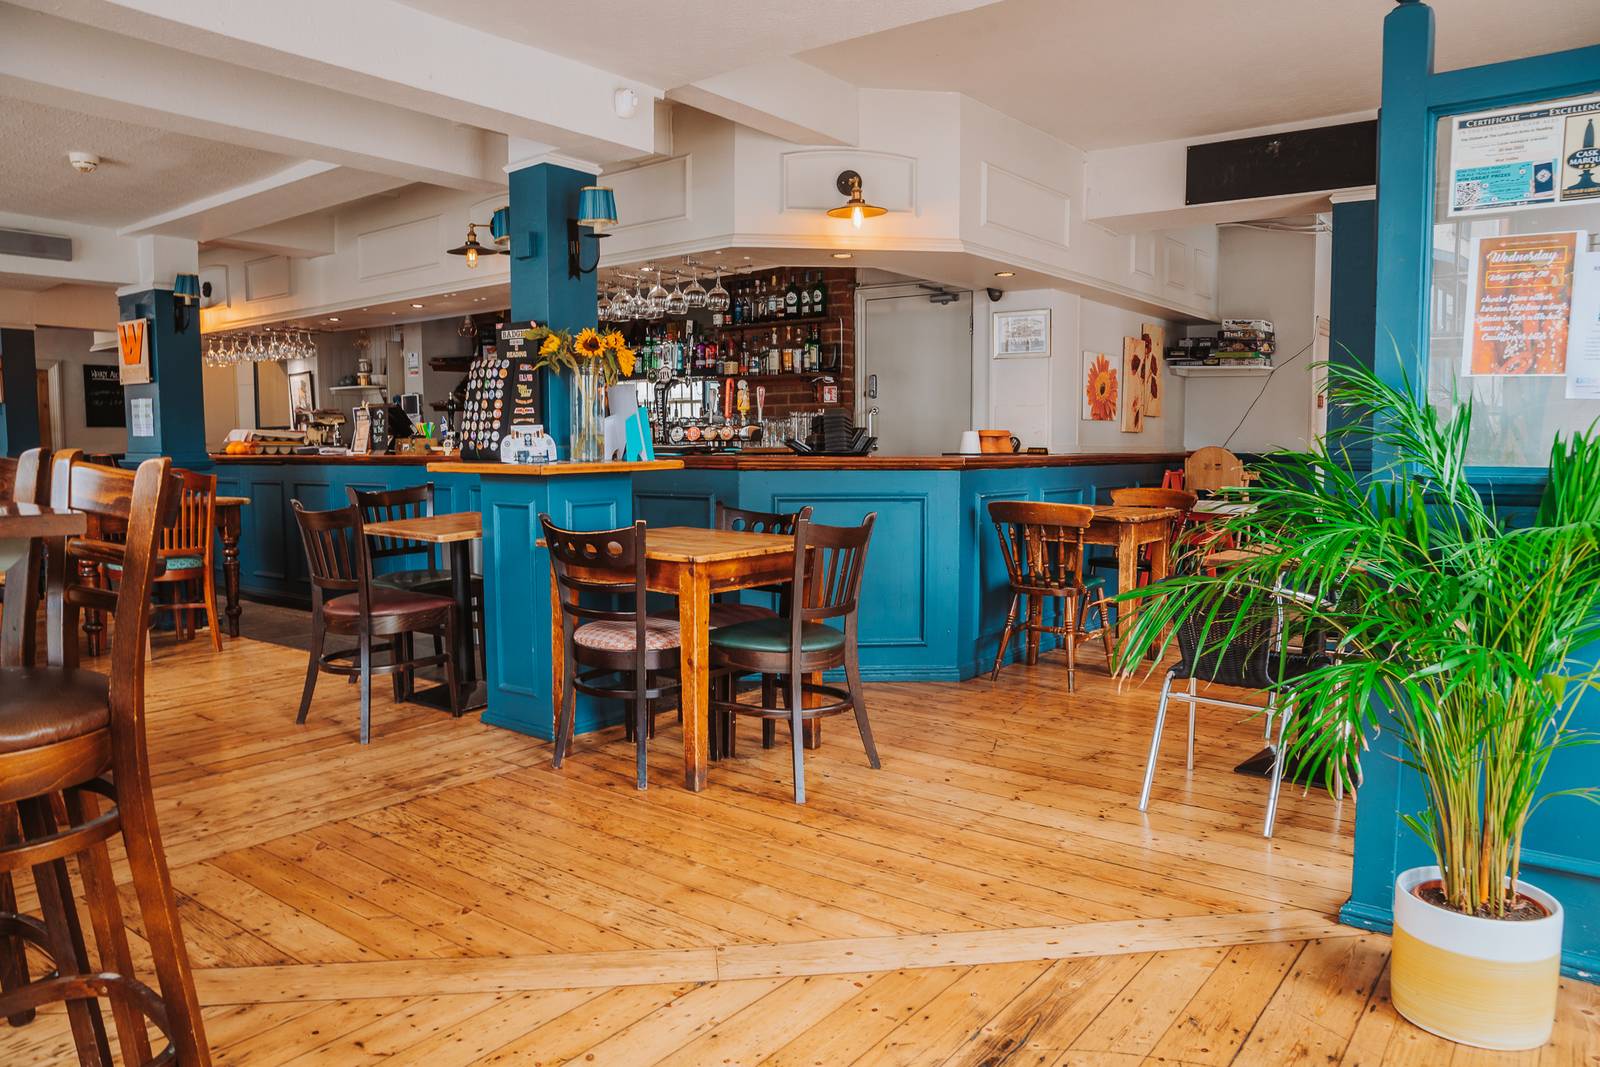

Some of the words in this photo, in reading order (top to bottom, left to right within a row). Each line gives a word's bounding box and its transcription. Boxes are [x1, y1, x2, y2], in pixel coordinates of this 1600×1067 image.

[1466, 114, 1520, 127] CERTIFICATE
[1576, 150, 1599, 158] CASK
[659, 370, 671, 379] IPA
